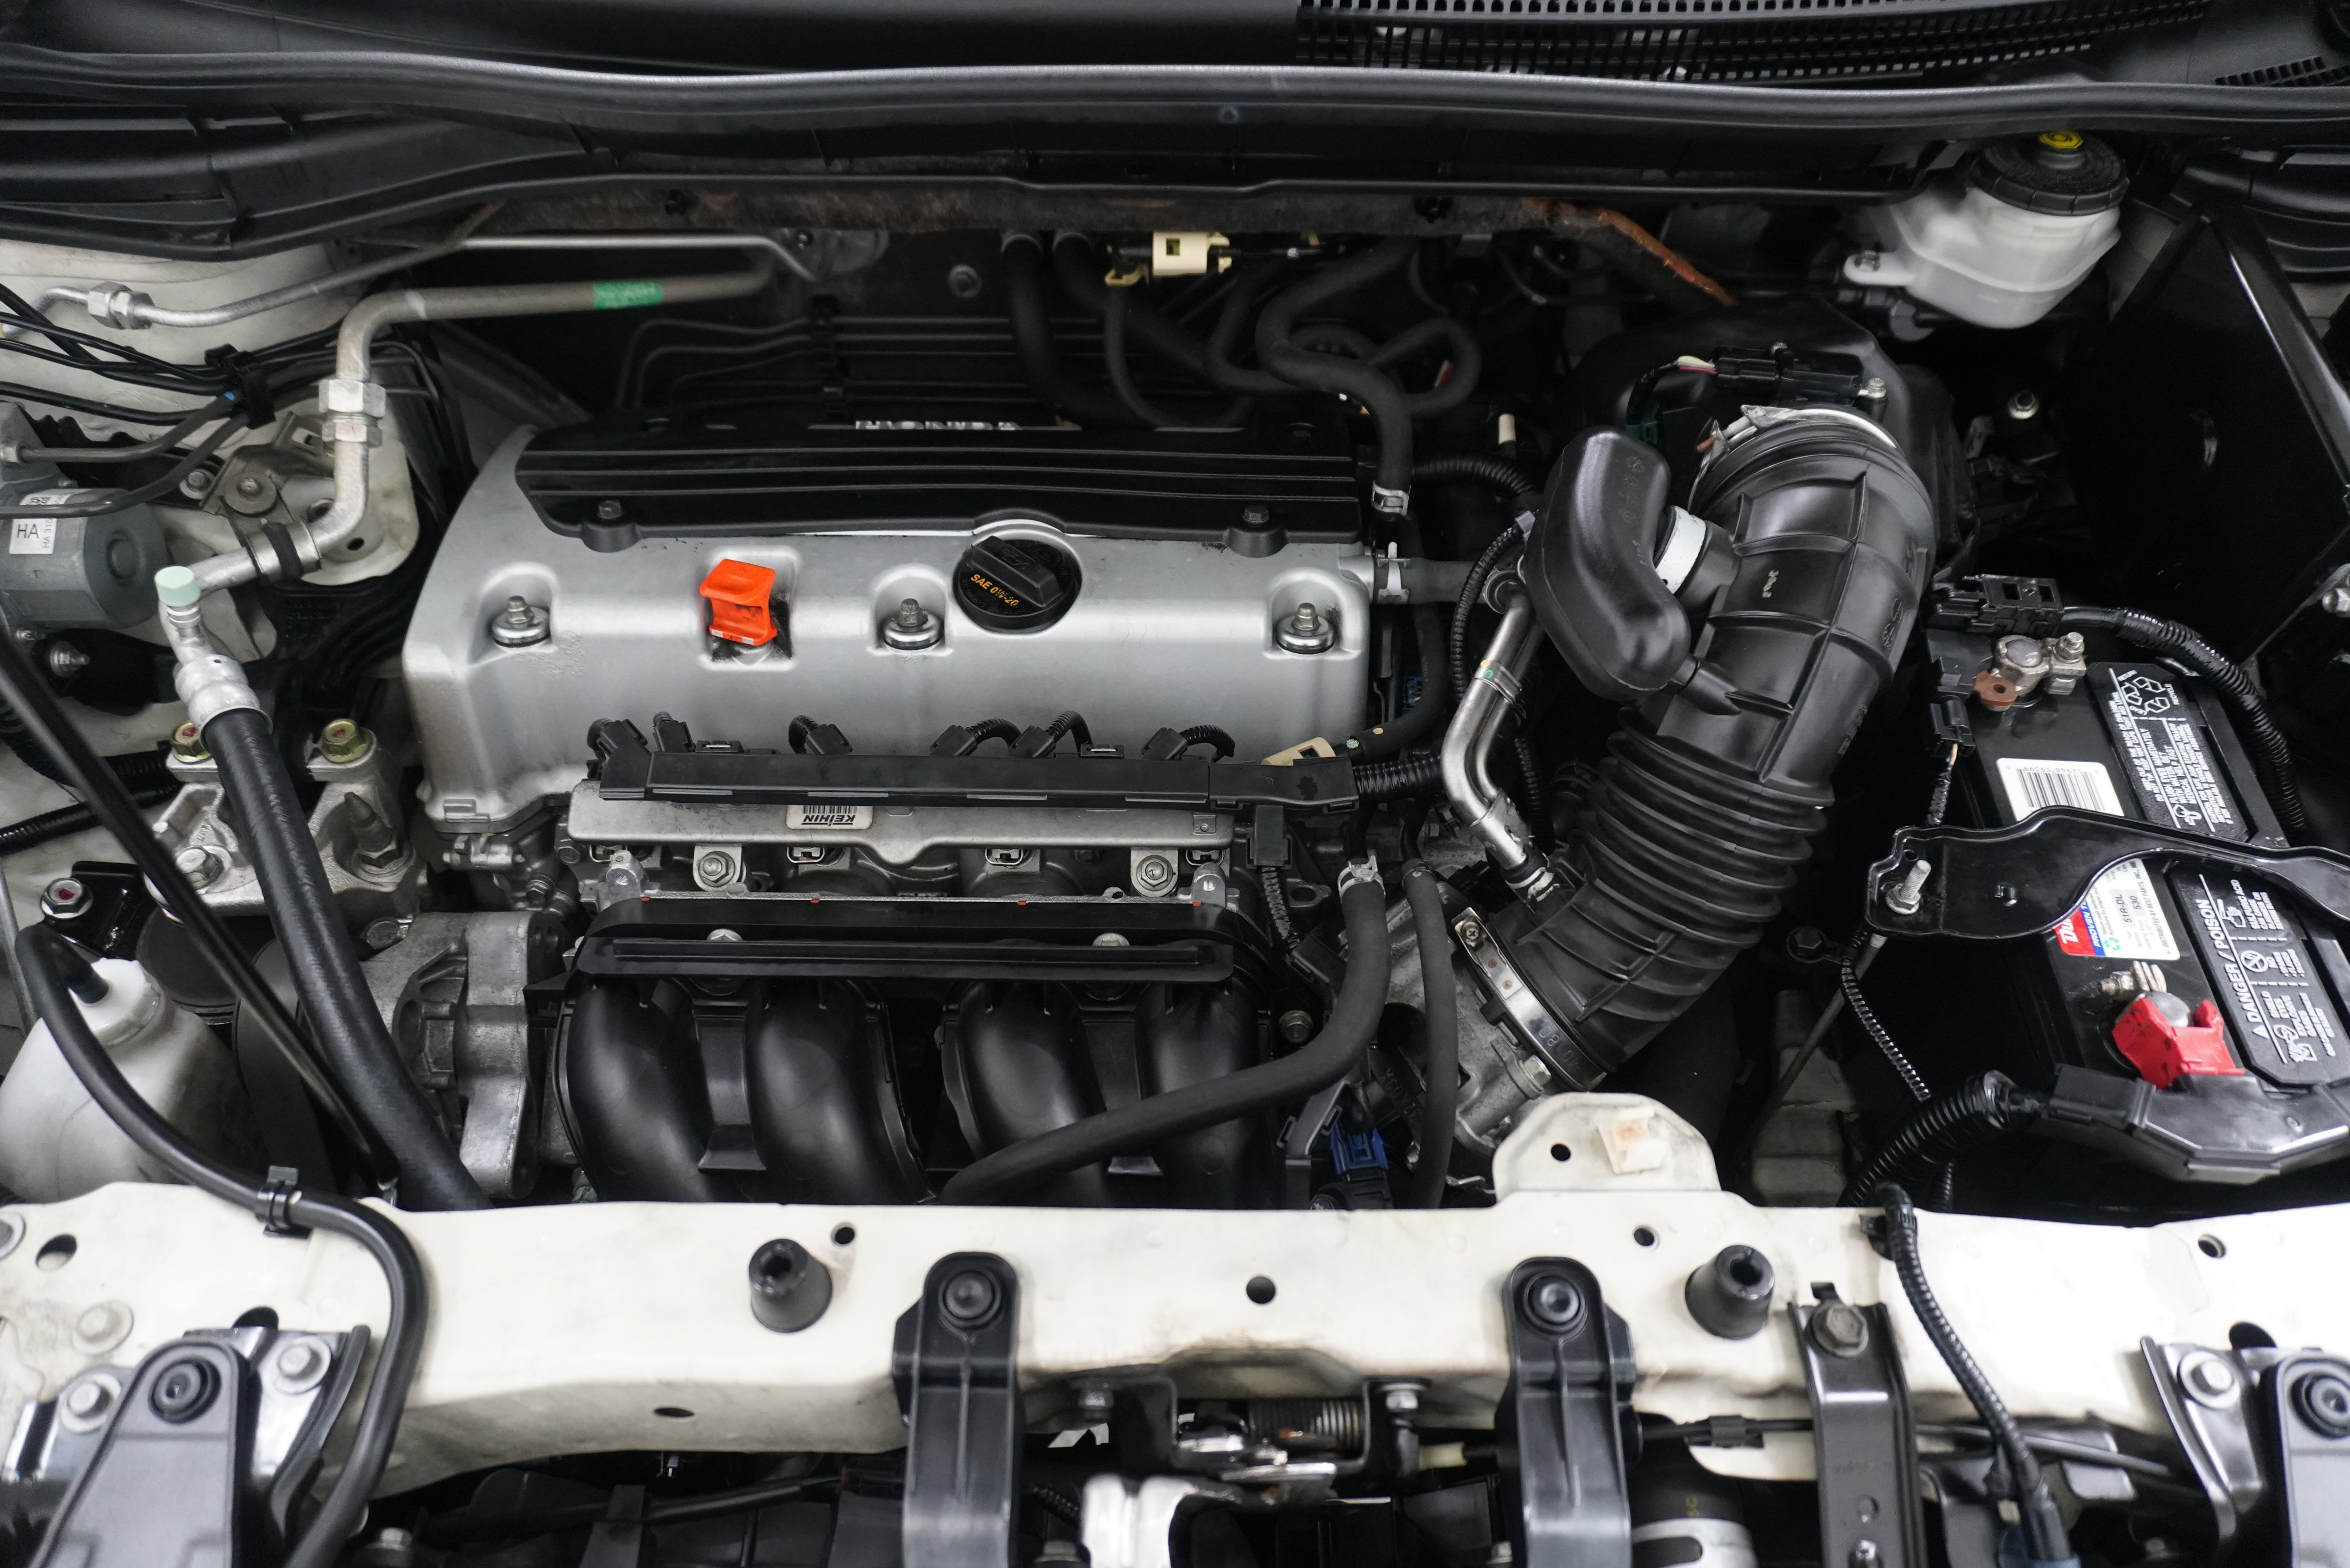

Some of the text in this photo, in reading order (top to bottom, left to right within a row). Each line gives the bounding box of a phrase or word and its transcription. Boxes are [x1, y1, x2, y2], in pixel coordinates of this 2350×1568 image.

[17, 523, 39, 539] HA
[42, 536, 50, 548] HA
[971, 574, 993, 589] SAE
[2117, 669, 2137, 681] RETURN
[2164, 683, 2180, 705] RECYCLE
[2129, 748, 2139, 757] THE
[2133, 744, 2145, 757] VENT
[2157, 751, 2171, 763] GET
[2139, 728, 2179, 803] FLUSH EYES IMMEDIATELY
[2164, 745, 2197, 804] MEDICAL HELP FAST
[2150, 783, 2161, 793] NOT
[2173, 789, 2188, 803] WITH
[803, 814, 856, 823] KEIHIN
[2113, 894, 2132, 922] 51R-DL
[2129, 896, 2142, 909] 530
[2144, 898, 2153, 908] BEST
[2229, 879, 2261, 929] SULFURIC ACID
[2083, 911, 2101, 946] PROVEN
[2098, 921, 2107, 935] Return
[2103, 916, 2114, 935] AutoZone
[2194, 899, 2230, 949] POISON
[2256, 917, 2269, 929] CAN
[2152, 918, 2169, 946] DISTRIBUTED
[2265, 956, 2278, 968] NO
[2222, 963, 2263, 1022] DANGER
[2260, 991, 2281, 1018] SHIELD
[2273, 998, 2290, 1018] EYES
[2280, 995, 2308, 1036] EXPLOSIVE
[2297, 1010, 2317, 1036] GASES
